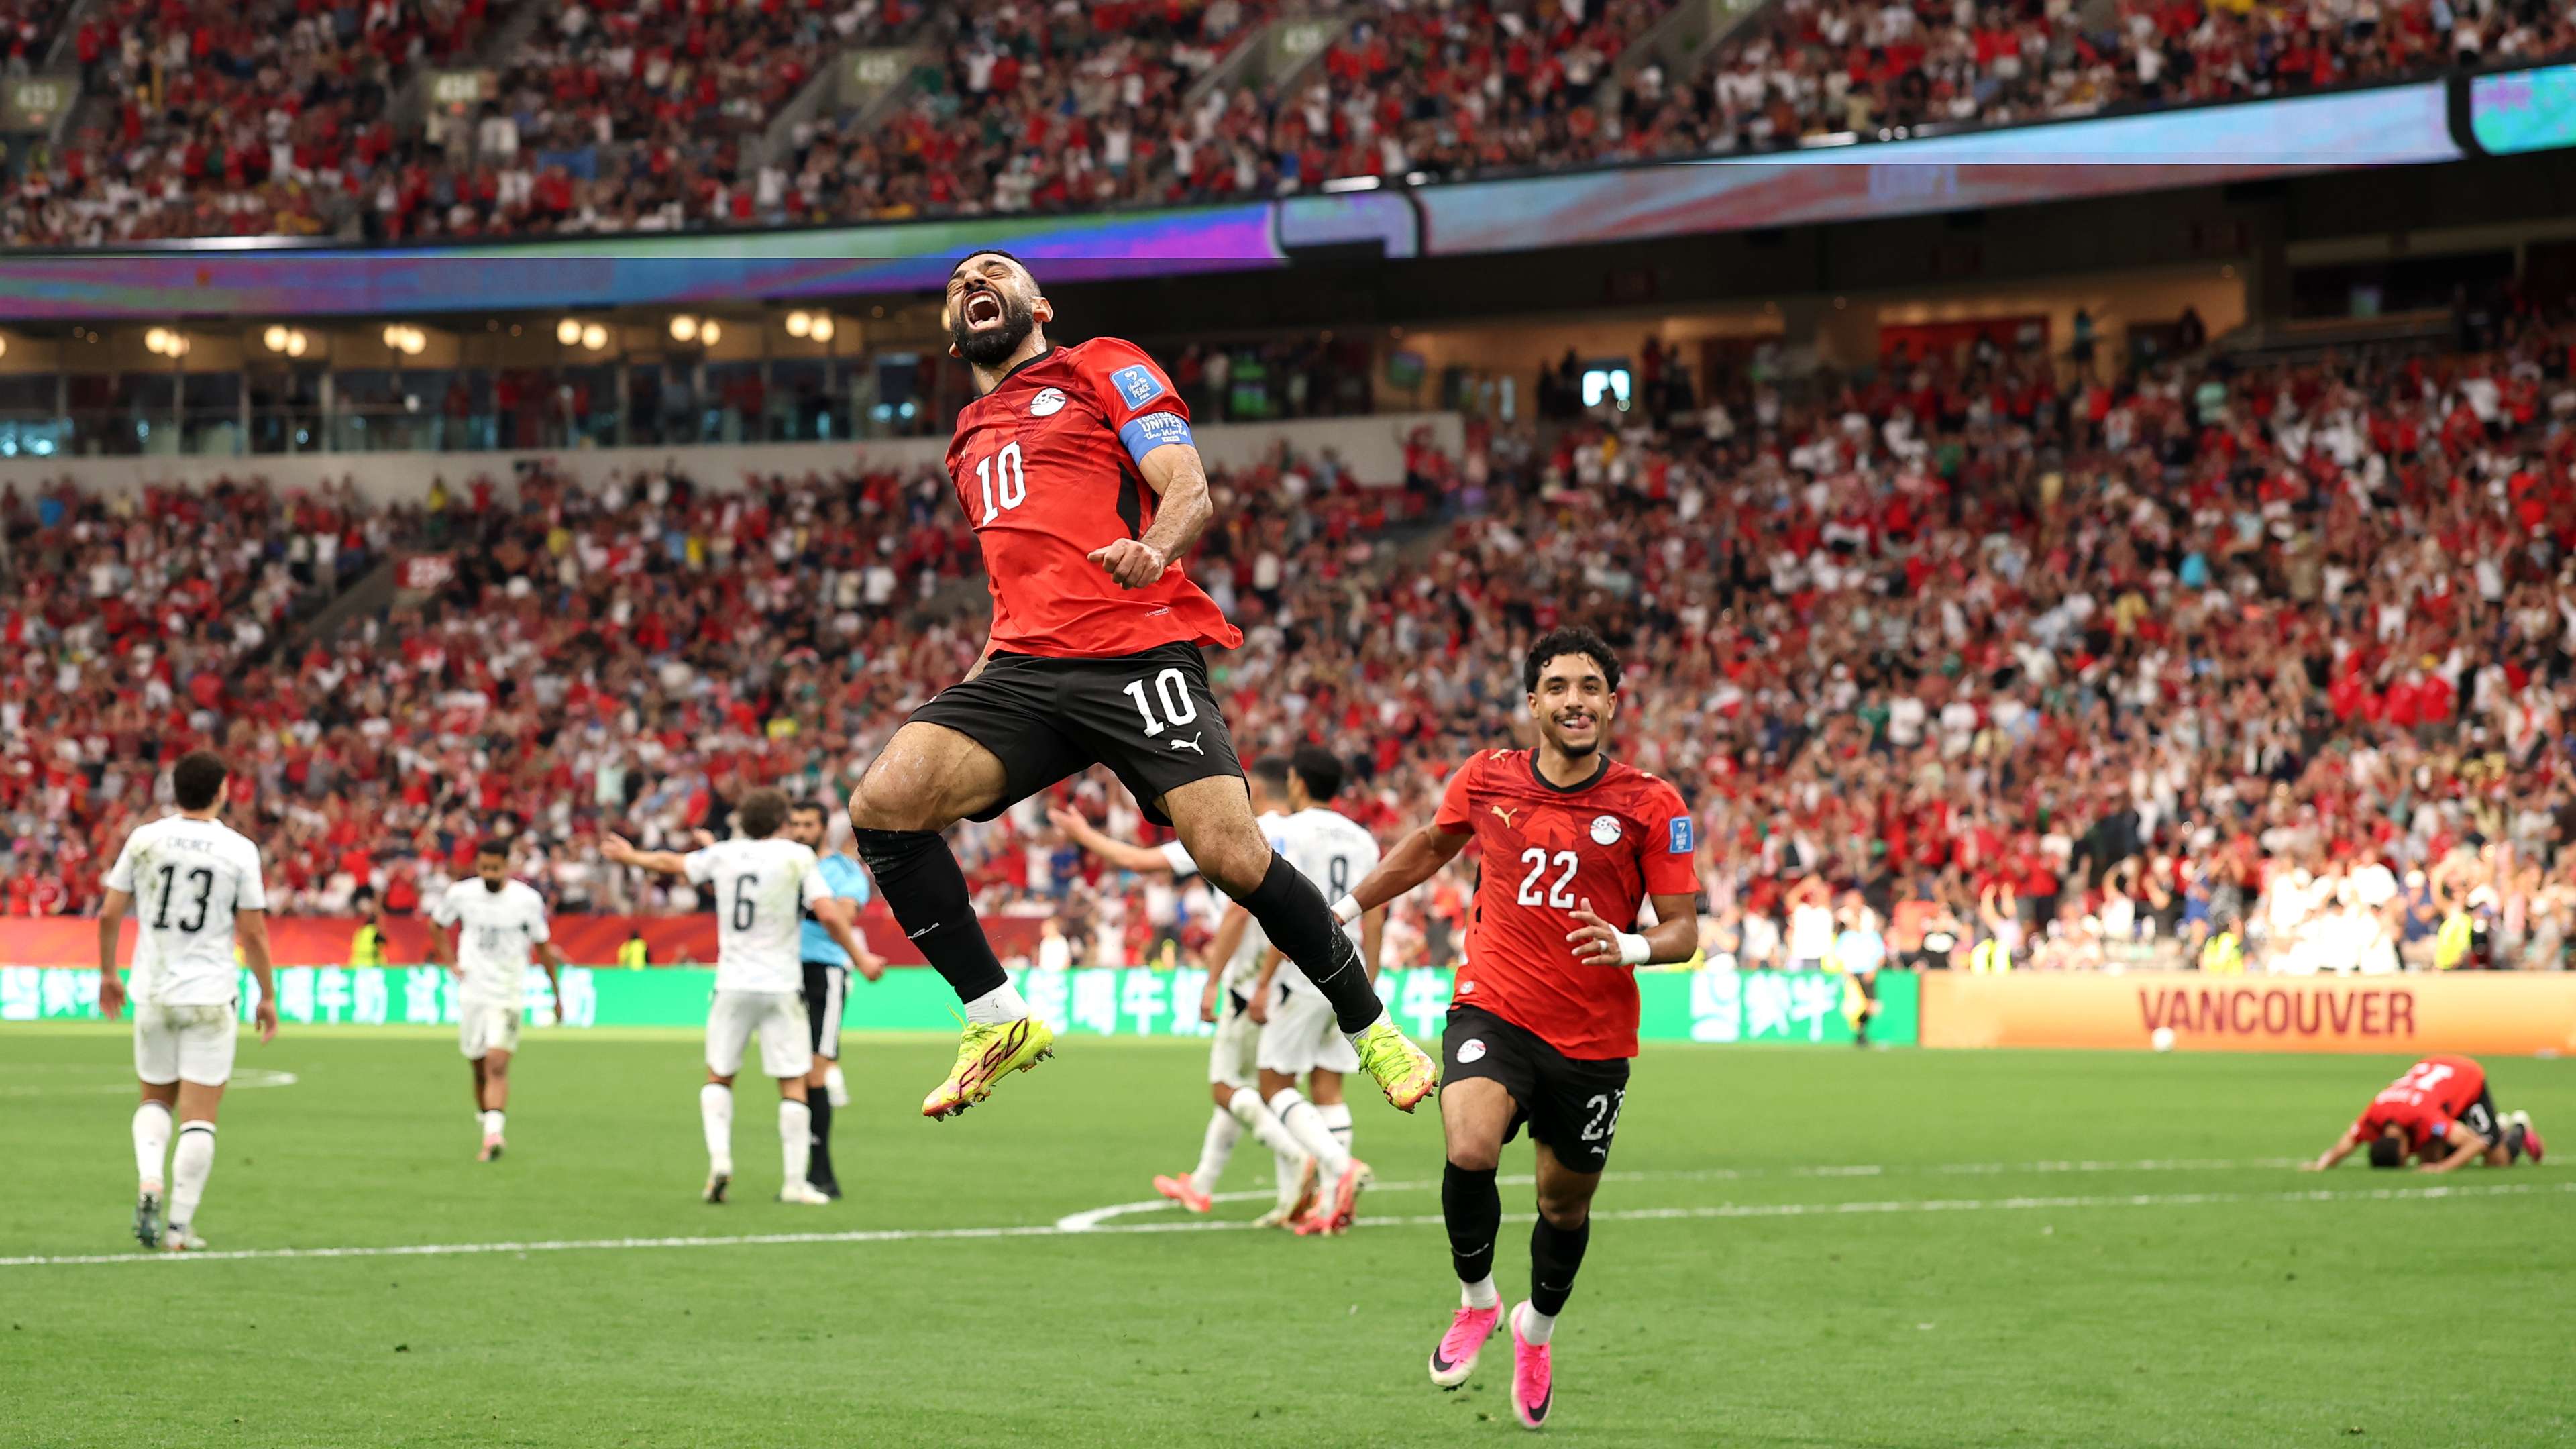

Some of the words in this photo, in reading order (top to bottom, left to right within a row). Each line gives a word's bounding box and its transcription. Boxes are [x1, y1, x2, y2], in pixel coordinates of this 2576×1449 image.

[1132, 382, 1152, 398] PEACE
[1142, 417, 1183, 432] UNITES
[1144, 431, 1161, 440] the
[1161, 427, 1187, 437] World
[975, 440, 1027, 527] 10
[1122, 668, 1197, 738] 10
[154, 863, 213, 932] 13
[733, 873, 759, 932] 6
[1329, 854, 1348, 907] 8
[1517, 847, 1578, 909] 22
[2139, 989, 2415, 1036] VANCOUVER
